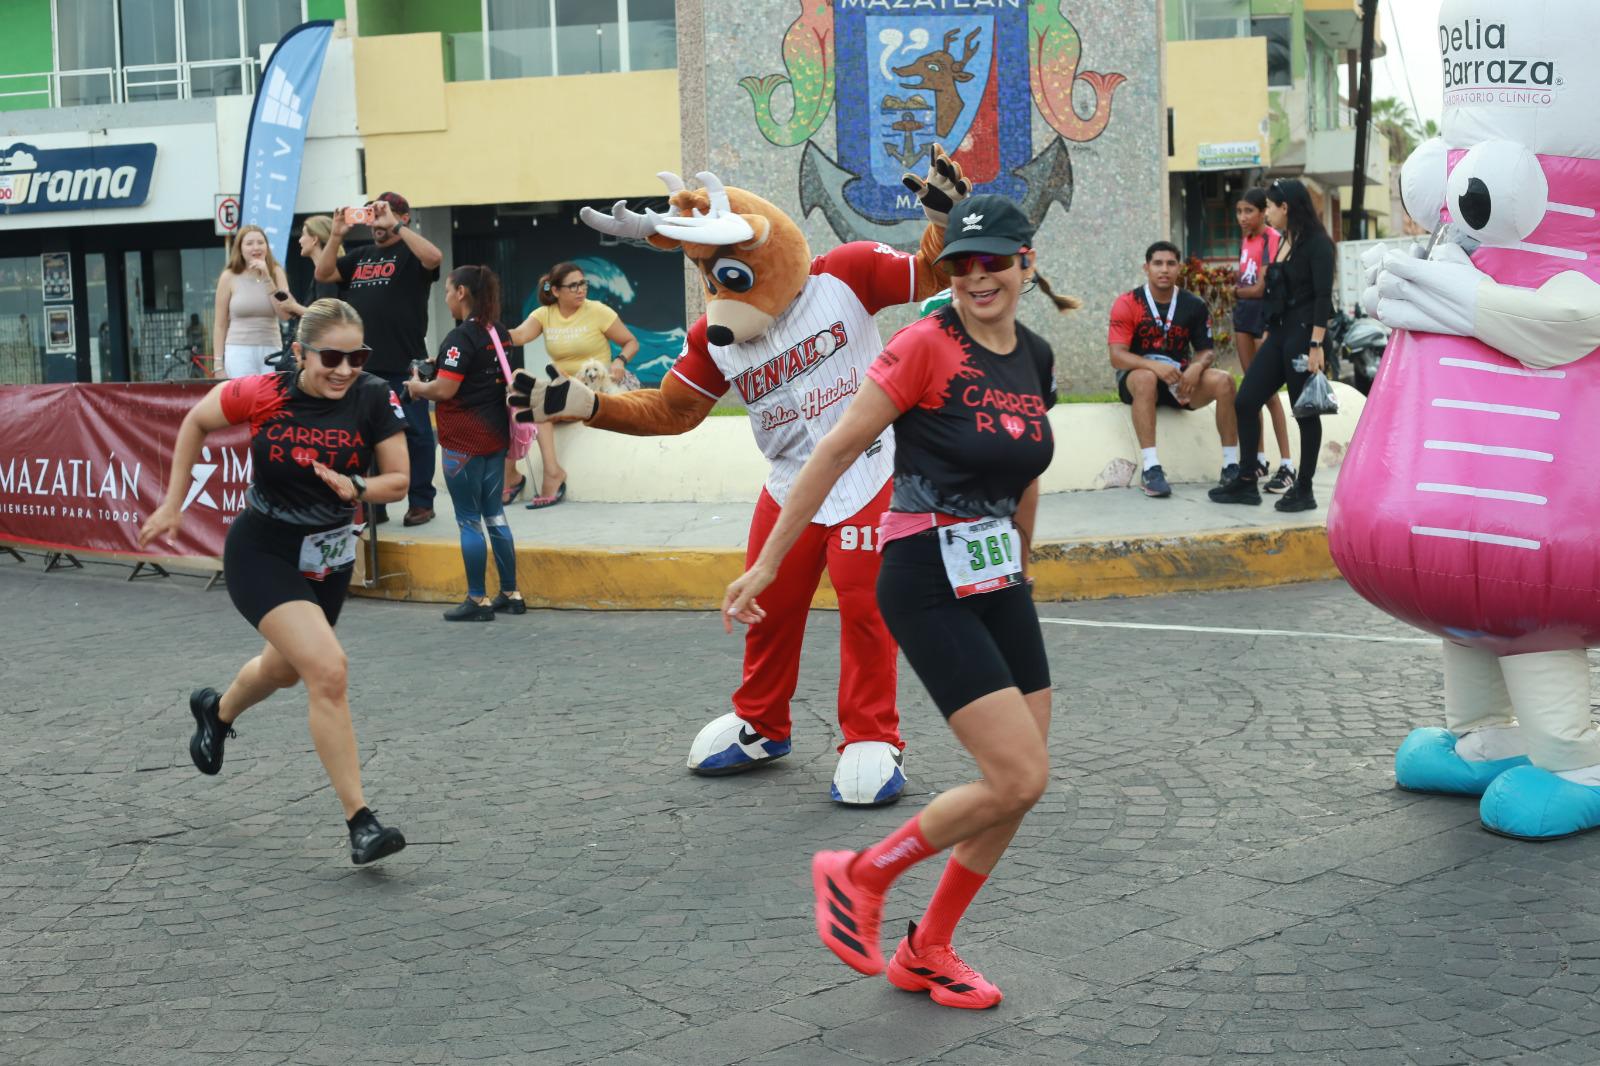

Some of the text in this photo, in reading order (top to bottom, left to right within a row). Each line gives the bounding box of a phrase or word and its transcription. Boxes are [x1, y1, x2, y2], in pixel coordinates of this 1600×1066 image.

[1440, 18, 1505, 55] Delia
[1443, 57, 1554, 88] Barraza
[27, 165, 137, 204] rama
[225, 204, 235, 223] E
[266, 423, 365, 448] CARRERA
[0, 451, 141, 501] MAZATLÁN
[0, 503, 139, 523] IENESTAR PARA TODOS
